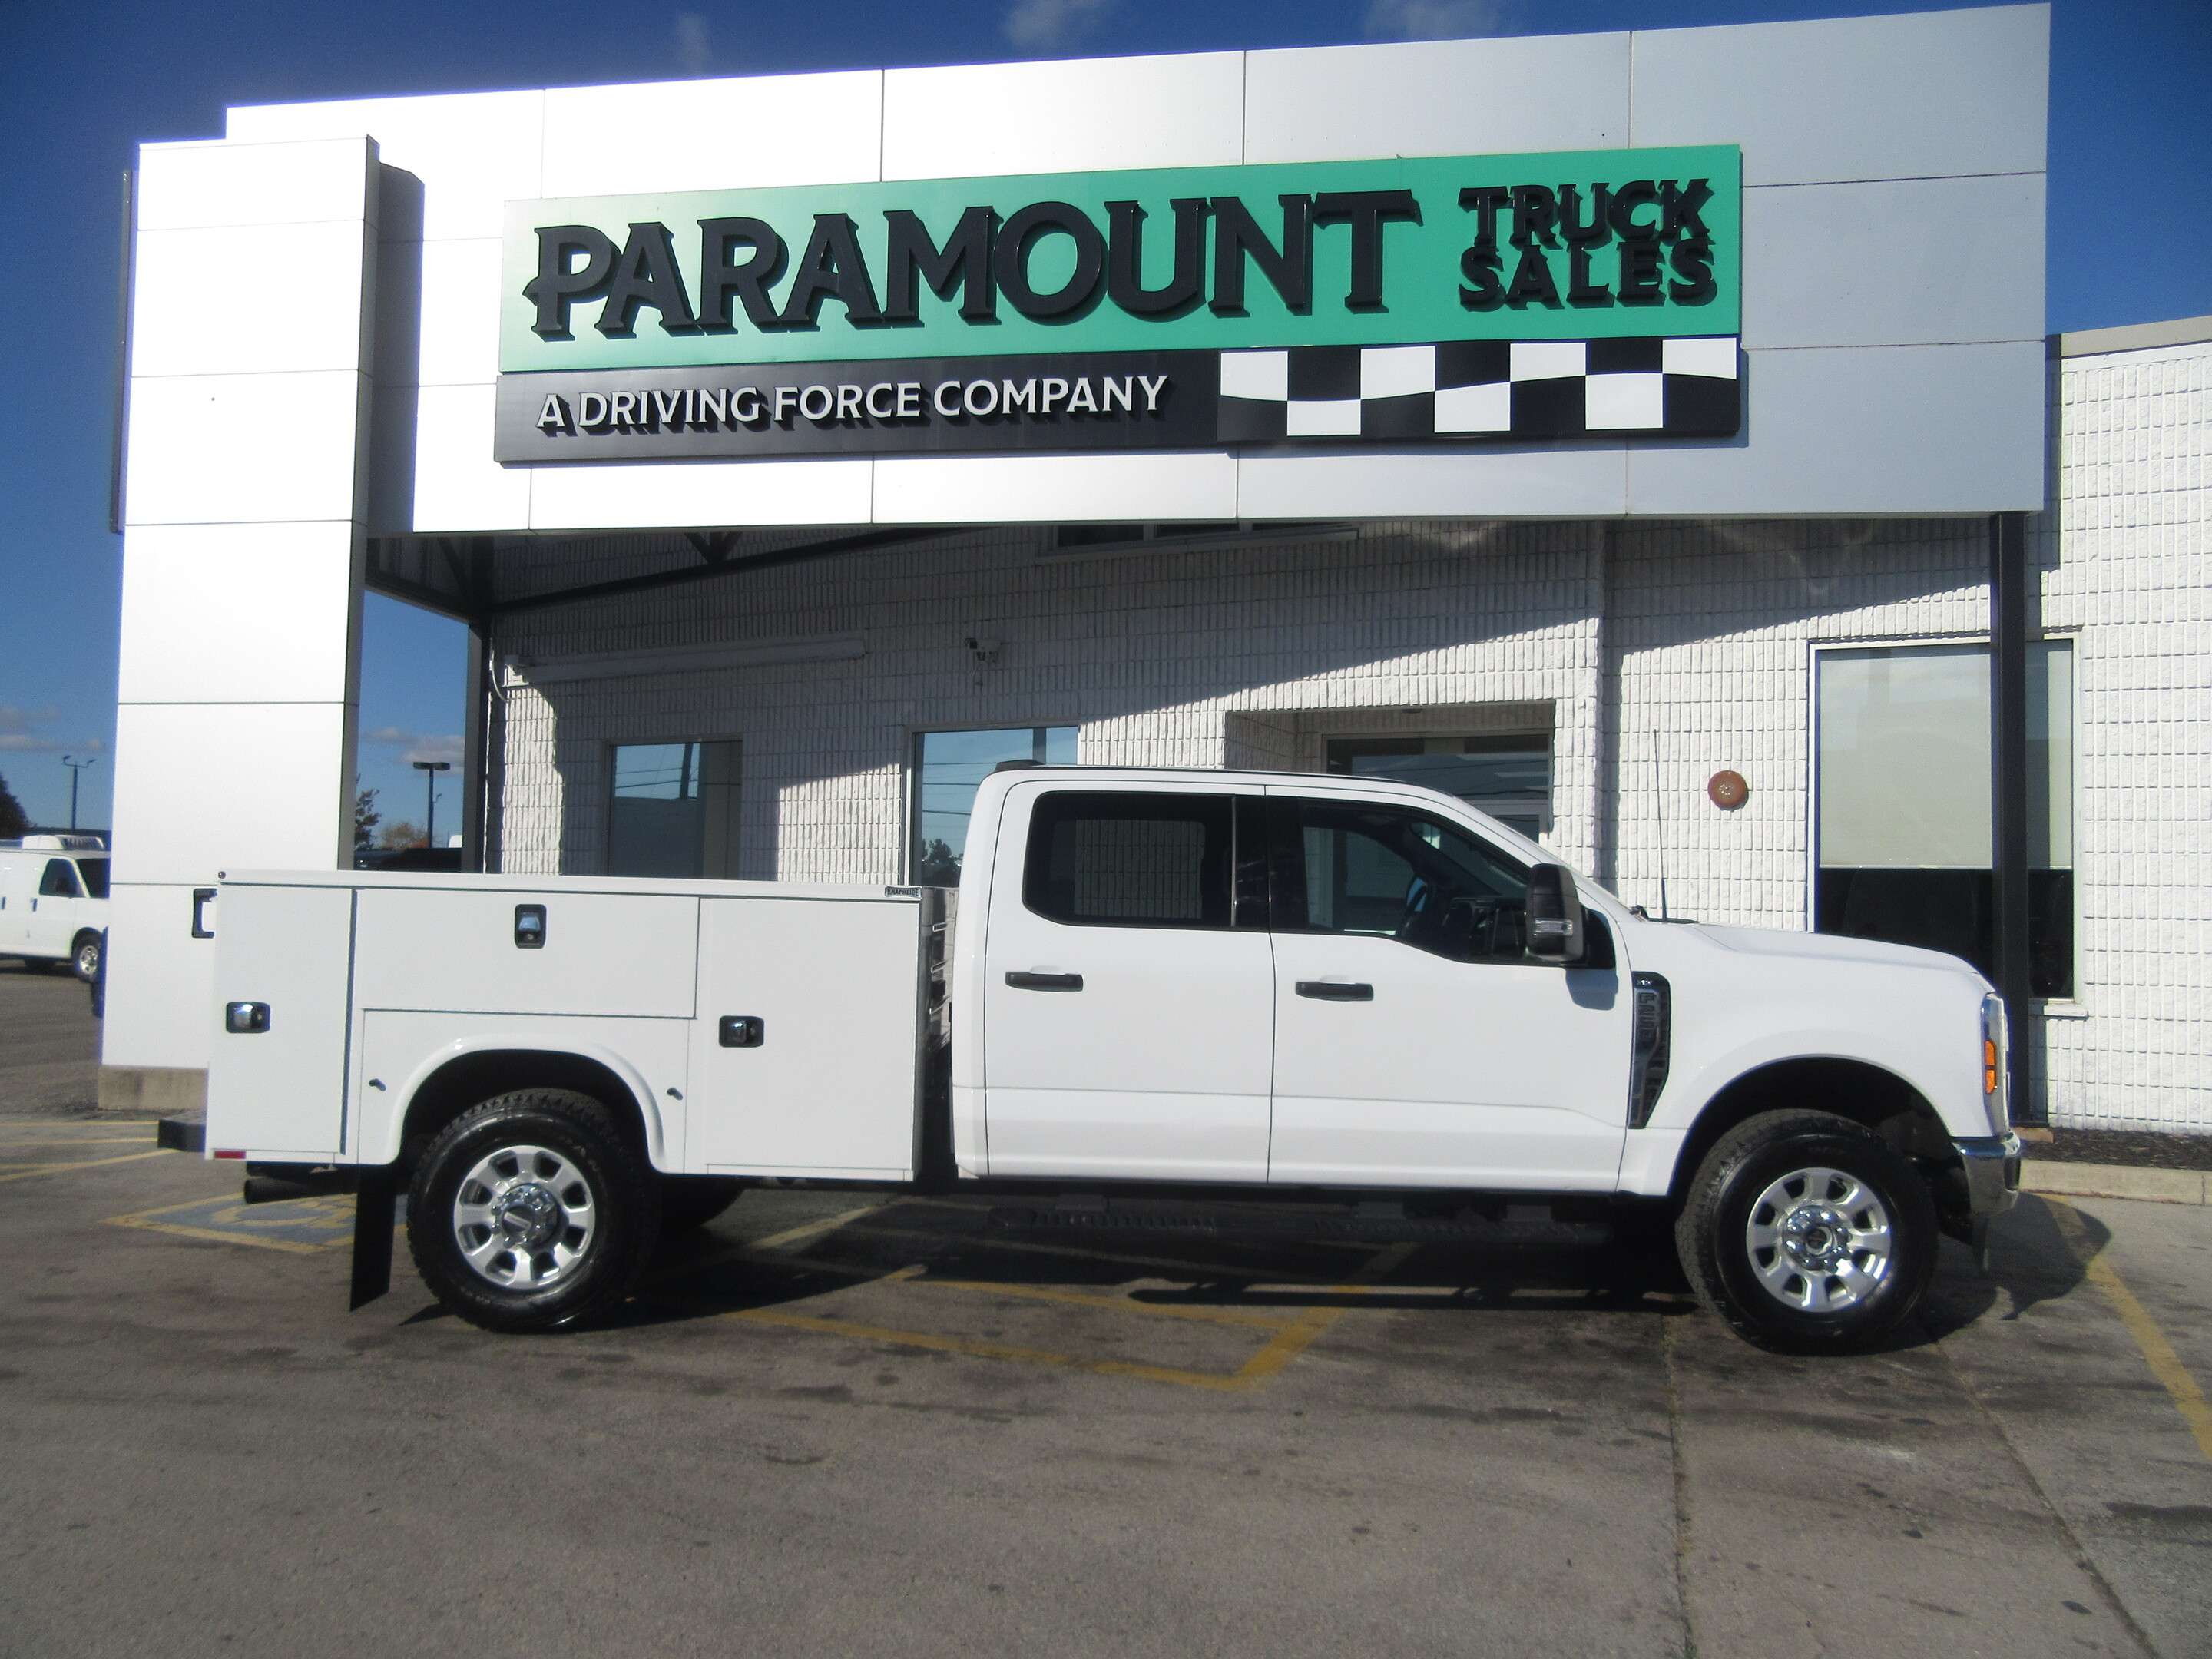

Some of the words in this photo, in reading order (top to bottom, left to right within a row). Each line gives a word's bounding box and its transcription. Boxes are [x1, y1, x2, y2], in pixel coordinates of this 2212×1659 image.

[1458, 178, 1710, 247] TRUCK
[522, 188, 1419, 341] PARAMOUNT
[1458, 239, 1717, 310] SALES
[536, 393, 565, 429] A
[577, 386, 762, 429] DRIVING
[773, 381, 922, 423] FORCE
[932, 373, 1170, 418] COMPANY
